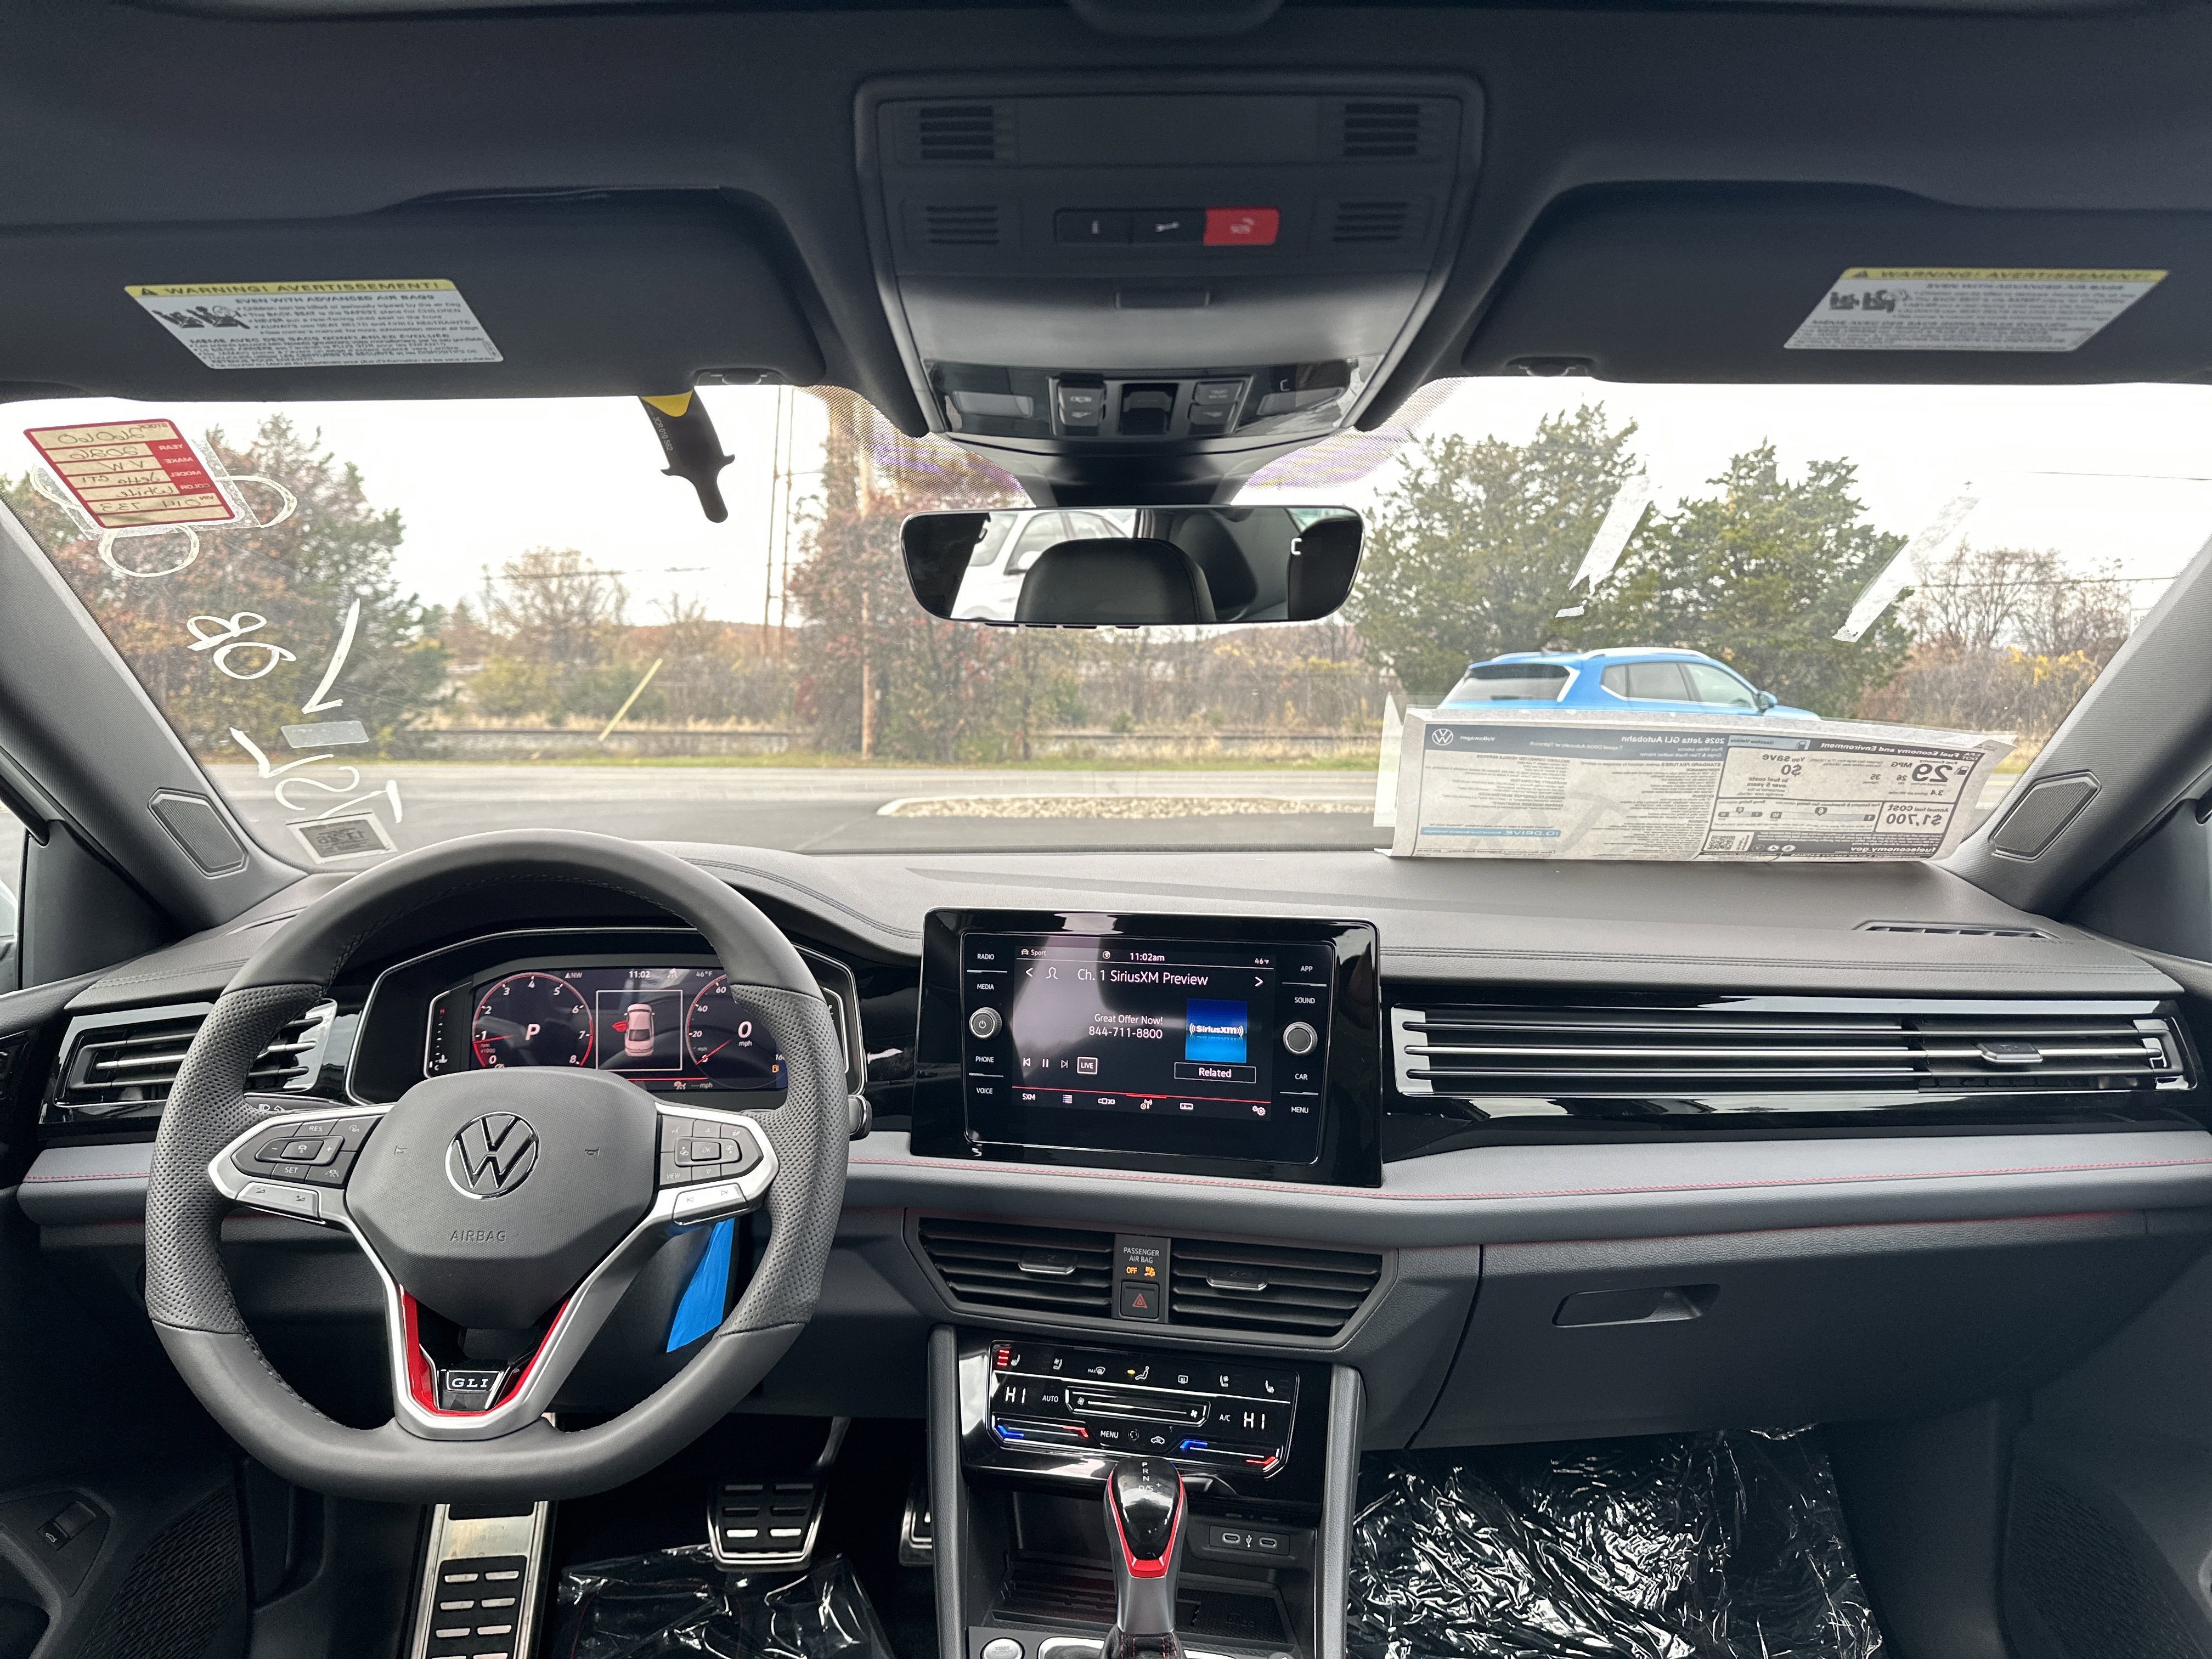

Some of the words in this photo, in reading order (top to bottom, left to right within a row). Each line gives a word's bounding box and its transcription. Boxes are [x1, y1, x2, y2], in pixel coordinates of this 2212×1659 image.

[165, 285, 268, 294] WARNING!
[278, 283, 438, 291] AVERTISSEMENT!
[658, 428, 668, 440] 010
[663, 439, 673, 452] 562
[1130, 952, 1165, 962] 11:02am
[1077, 968, 1096, 981] Ch.
[1100, 969, 1105, 981] 1
[1110, 970, 1159, 984] SiriusXM
[1163, 972, 1209, 985] Preview
[503, 987, 510, 996] 3
[553, 987, 560, 996] 5
[484, 1006, 492, 1014] 2
[572, 1005, 579, 1014] 6
[1094, 1013, 1116, 1023] Great
[1118, 1014, 1139, 1024] Offer
[1141, 1015, 1164, 1025] Now!
[525, 1023, 540, 1041] P
[578, 1030, 585, 1039] 7
[737, 1020, 752, 1039] 0
[1088, 1026, 1163, 1039] 844-711-8800
[481, 1030, 487, 1040] 1
[489, 1055, 497, 1064] 0
[569, 1054, 577, 1063] 8
[1199, 1067, 1232, 1078] Related
[450, 1230, 506, 1242] AIRBAG
[1123, 1246, 1160, 1256] PASSENGER
[452, 1378, 489, 1388] GLI
[1005, 1386, 1026, 1404] HI
[1042, 1395, 1059, 1403] AUTO
[1219, 1414, 1231, 1422] A/C
[1244, 1412, 1265, 1429] HI
[1100, 1430, 1119, 1438] MENU
